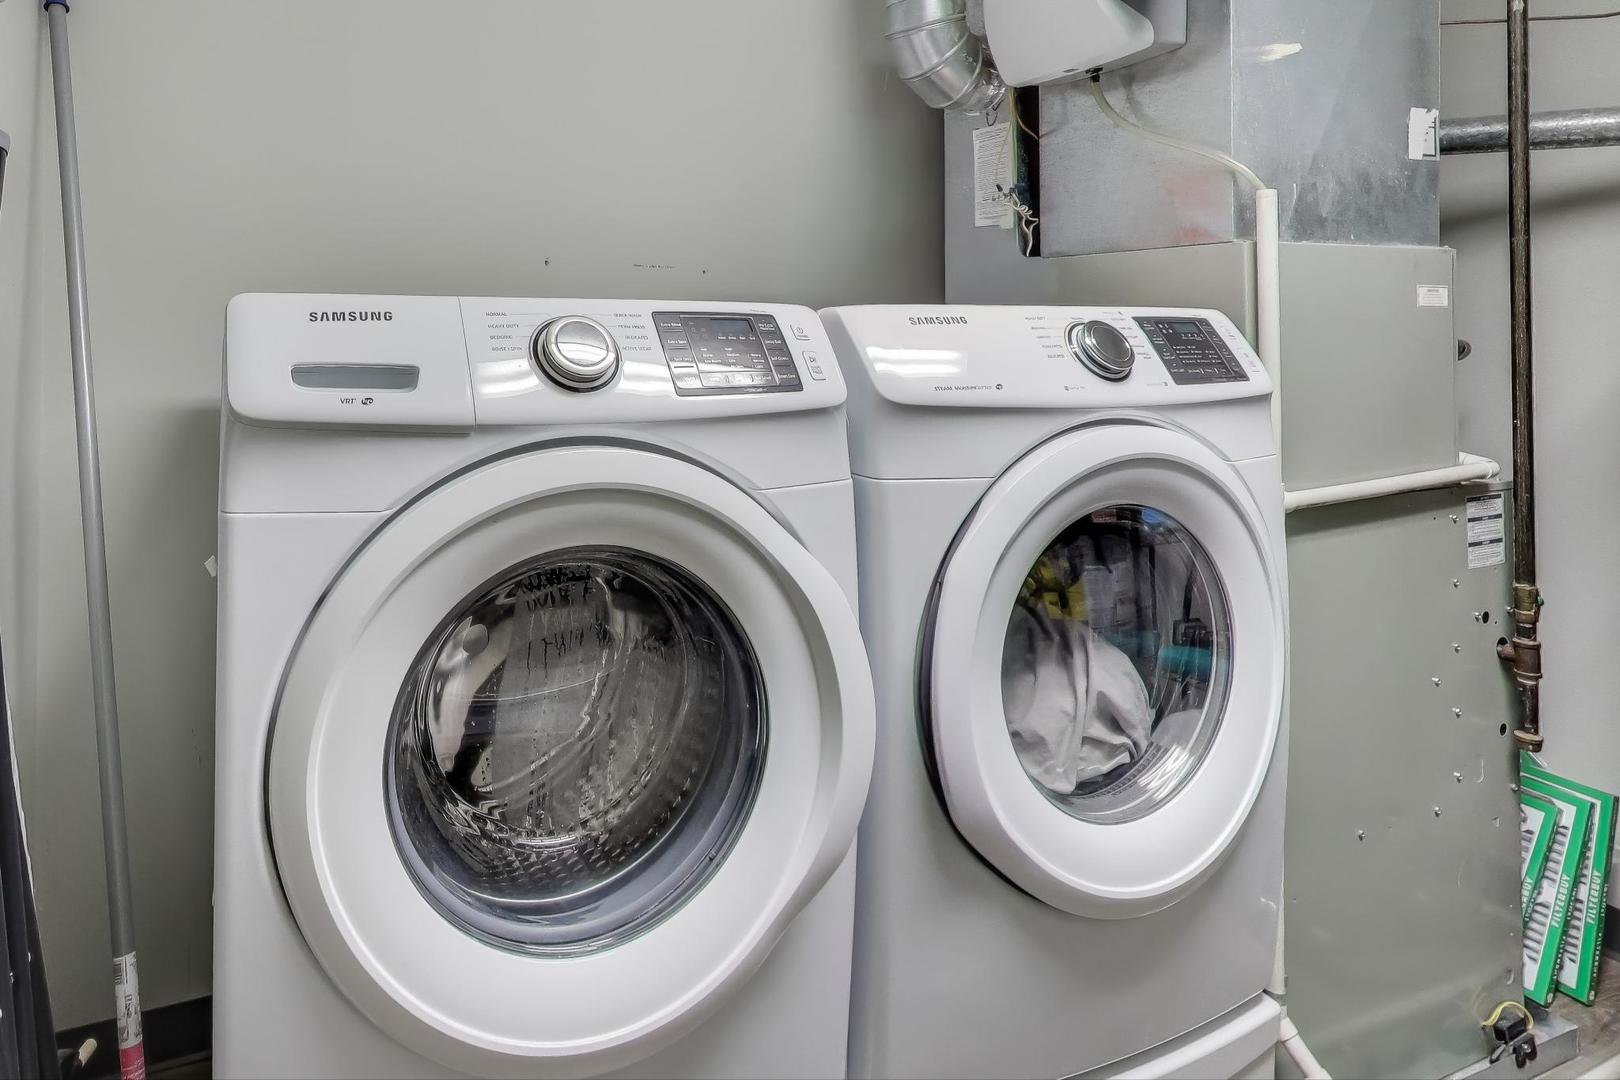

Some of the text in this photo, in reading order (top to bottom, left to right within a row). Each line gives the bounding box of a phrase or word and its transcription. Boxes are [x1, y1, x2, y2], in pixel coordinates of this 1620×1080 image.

[309, 311, 393, 322] SAMSUNG
[908, 316, 968, 326] SAMSUNG
[1550, 873, 1571, 928] FILTERBUY
[1586, 869, 1602, 925] FILTERBUY
